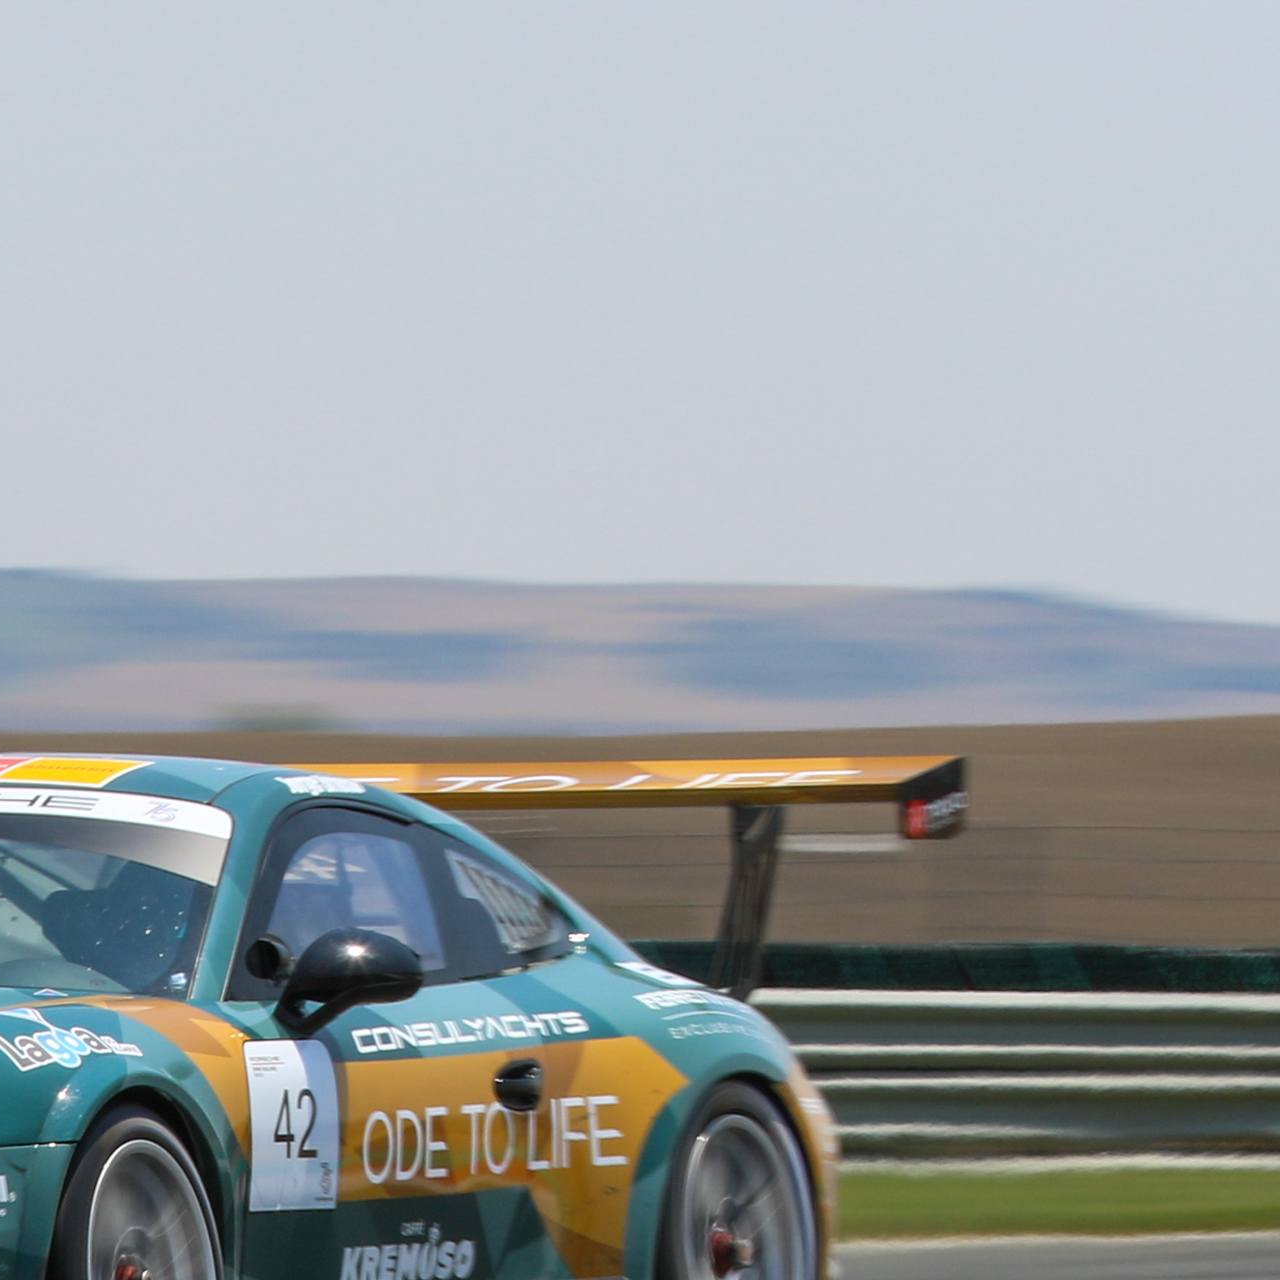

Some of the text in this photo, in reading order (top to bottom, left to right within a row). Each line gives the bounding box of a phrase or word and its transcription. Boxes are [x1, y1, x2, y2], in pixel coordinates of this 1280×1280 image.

[437, 769, 862, 792] TO LIFE
[351, 1010, 590, 1055] CONSULYACHTS
[273, 1088, 319, 1159] 42
[361, 1105, 451, 1184] ODE
[460, 1100, 516, 1175] TO
[526, 1094, 629, 1171] LIFE
